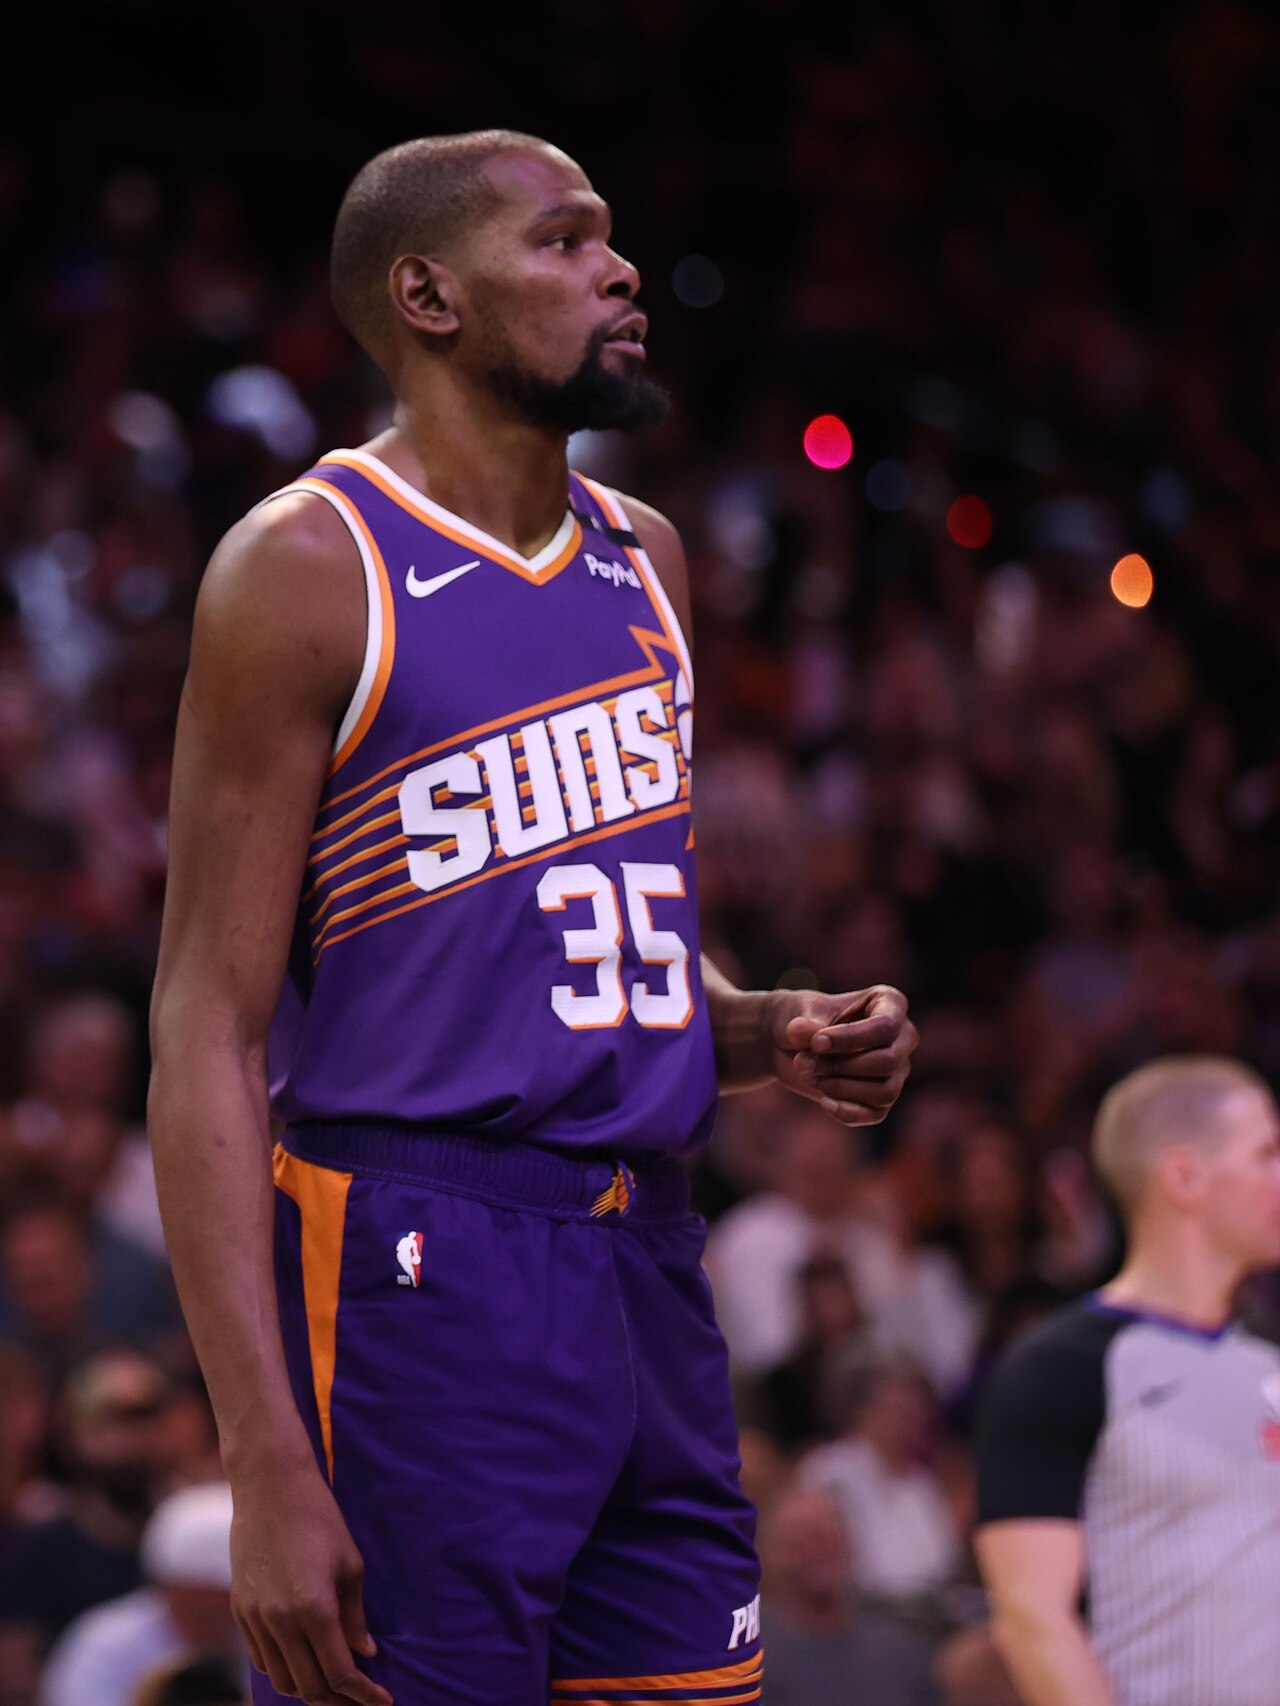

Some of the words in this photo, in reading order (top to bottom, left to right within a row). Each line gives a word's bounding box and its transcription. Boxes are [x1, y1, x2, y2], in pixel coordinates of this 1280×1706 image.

[397, 685, 680, 892] SUNS
[536, 861, 695, 1031] 35
[727, 1593, 761, 1651] PH
